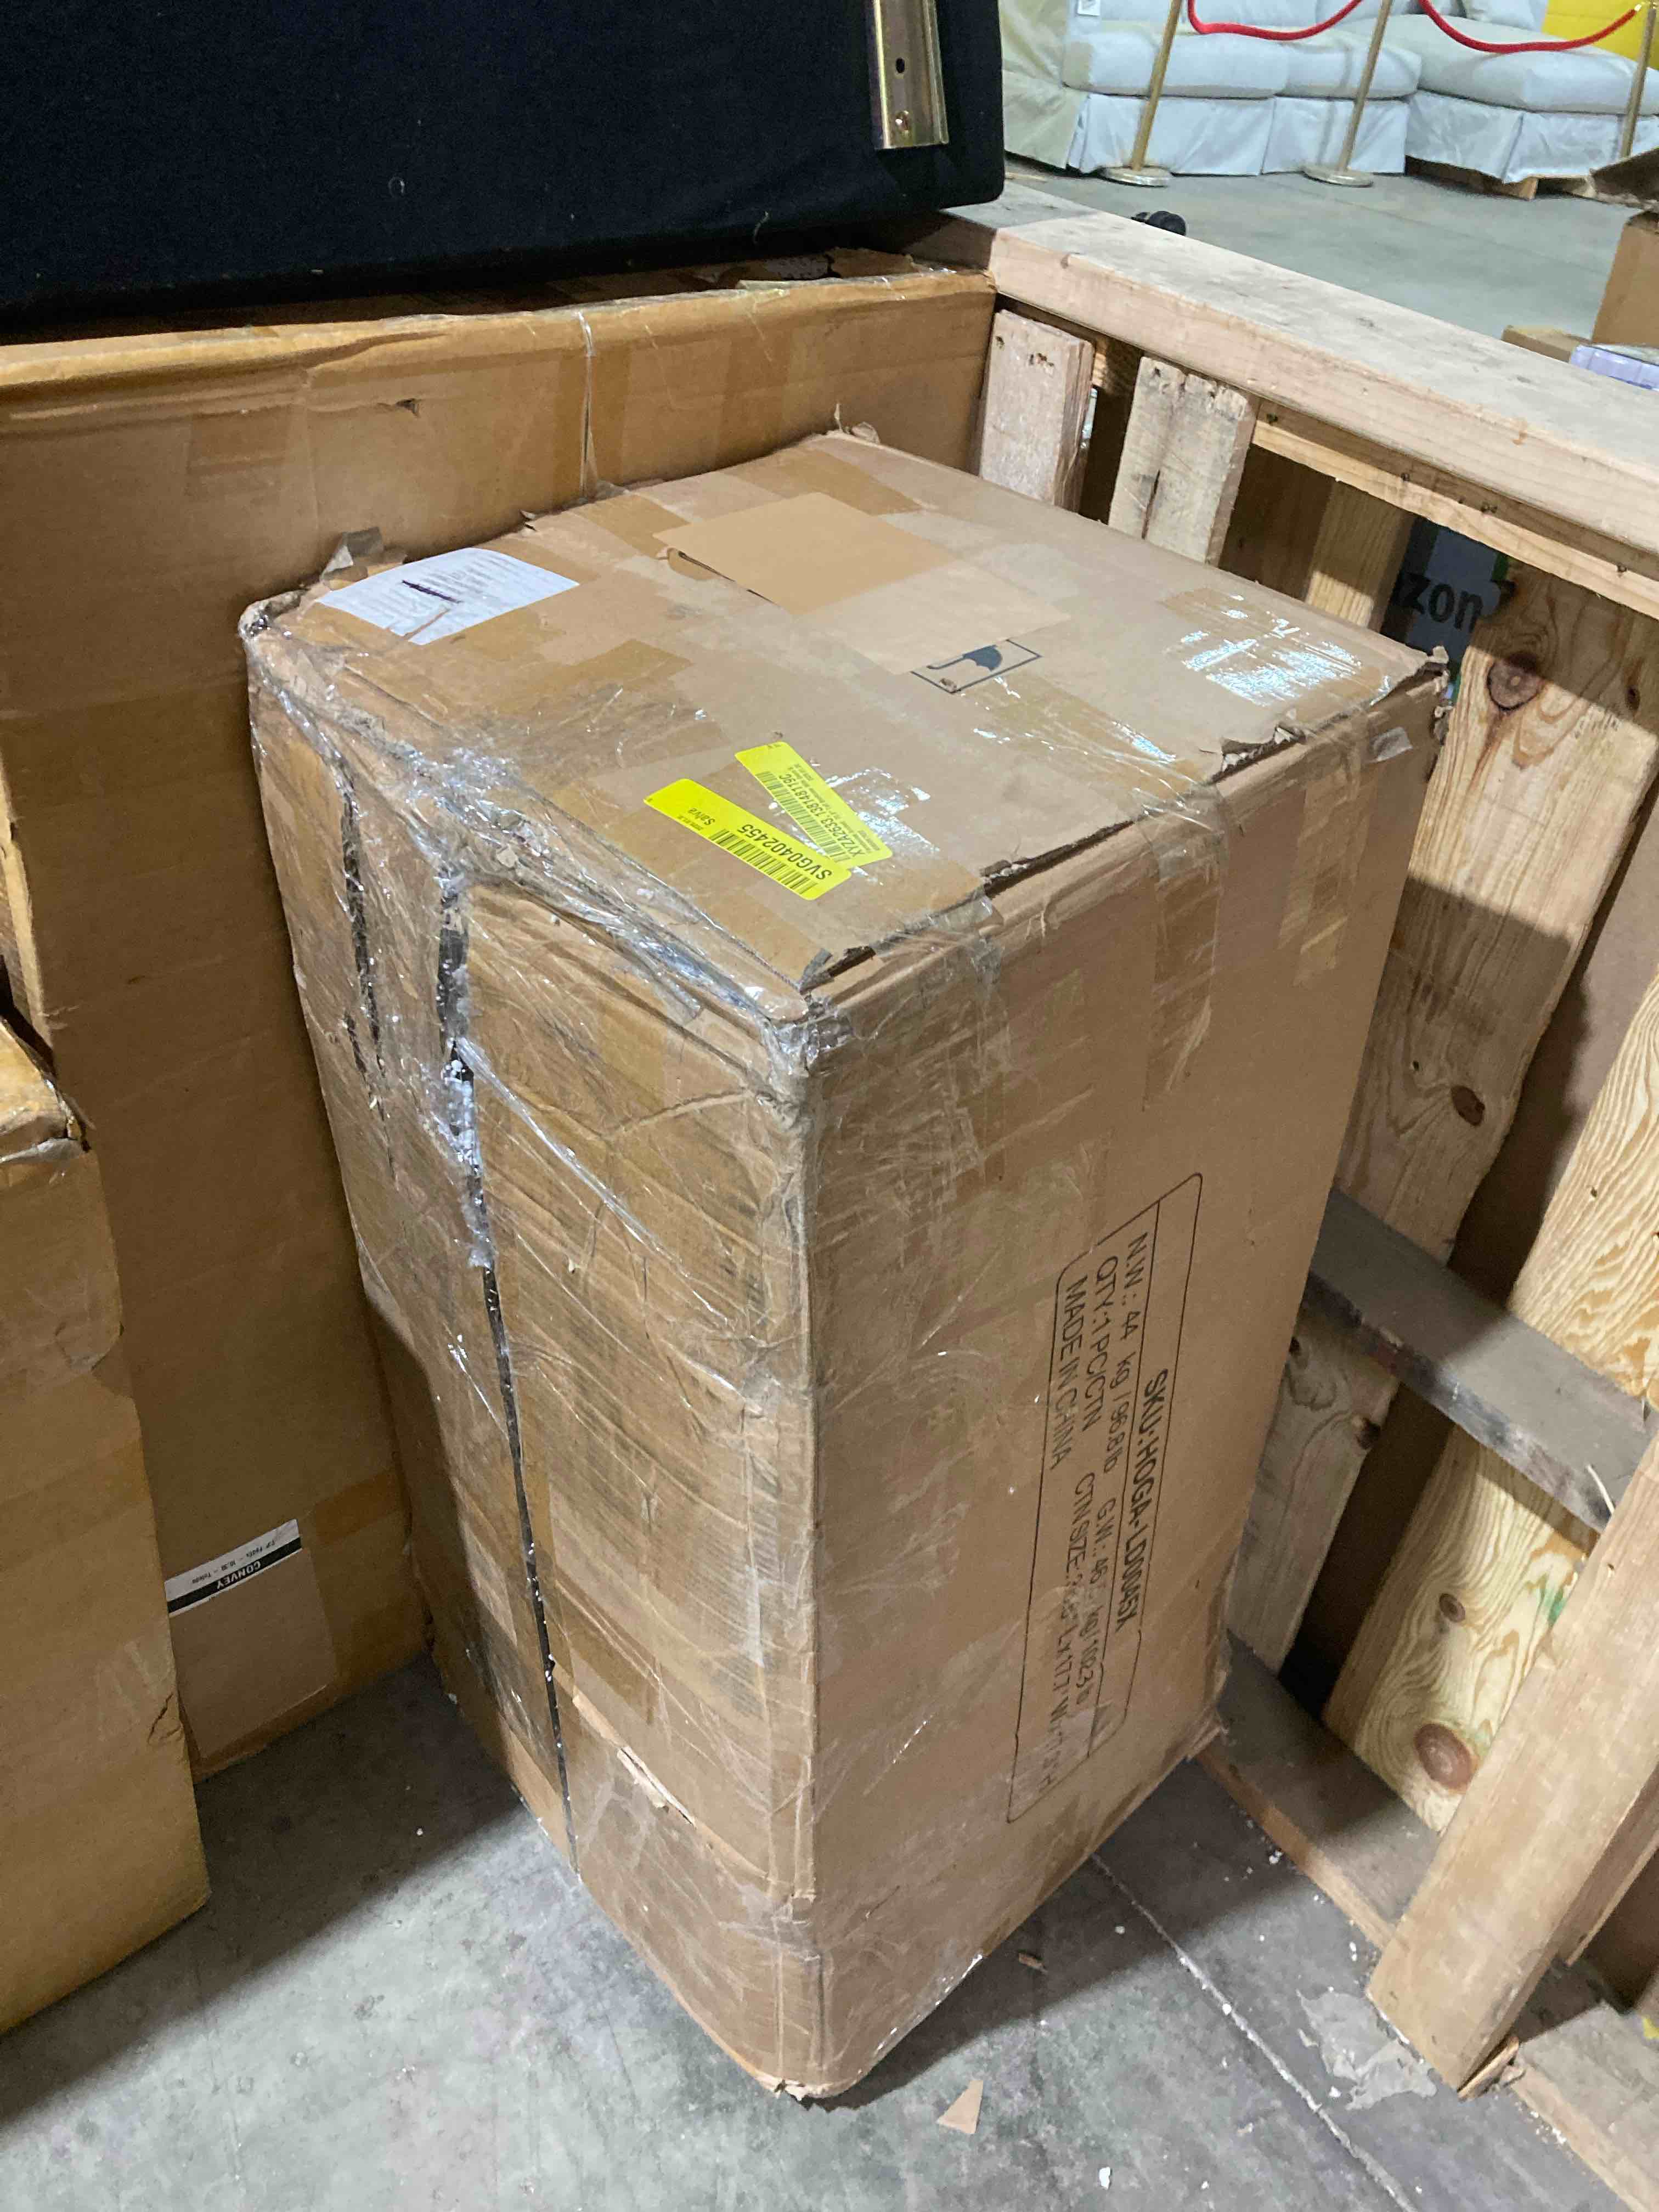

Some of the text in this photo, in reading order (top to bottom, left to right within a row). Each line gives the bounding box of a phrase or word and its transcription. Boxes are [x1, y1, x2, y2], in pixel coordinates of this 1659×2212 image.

[685, 807, 717, 826] Salva
[735, 822, 835, 881] SVG0402455
[1121, 1232, 1148, 1306] N.W.:
[1120, 1311, 1141, 1341] 44
[1049, 1274, 1088, 1471] MADE IN CHINA
[1109, 1351, 1136, 1390] kg
[1072, 1472, 1095, 1525] CTN
[1092, 1497, 1116, 1557] G.W.:
[216, 1559, 261, 1590] CONVEY
